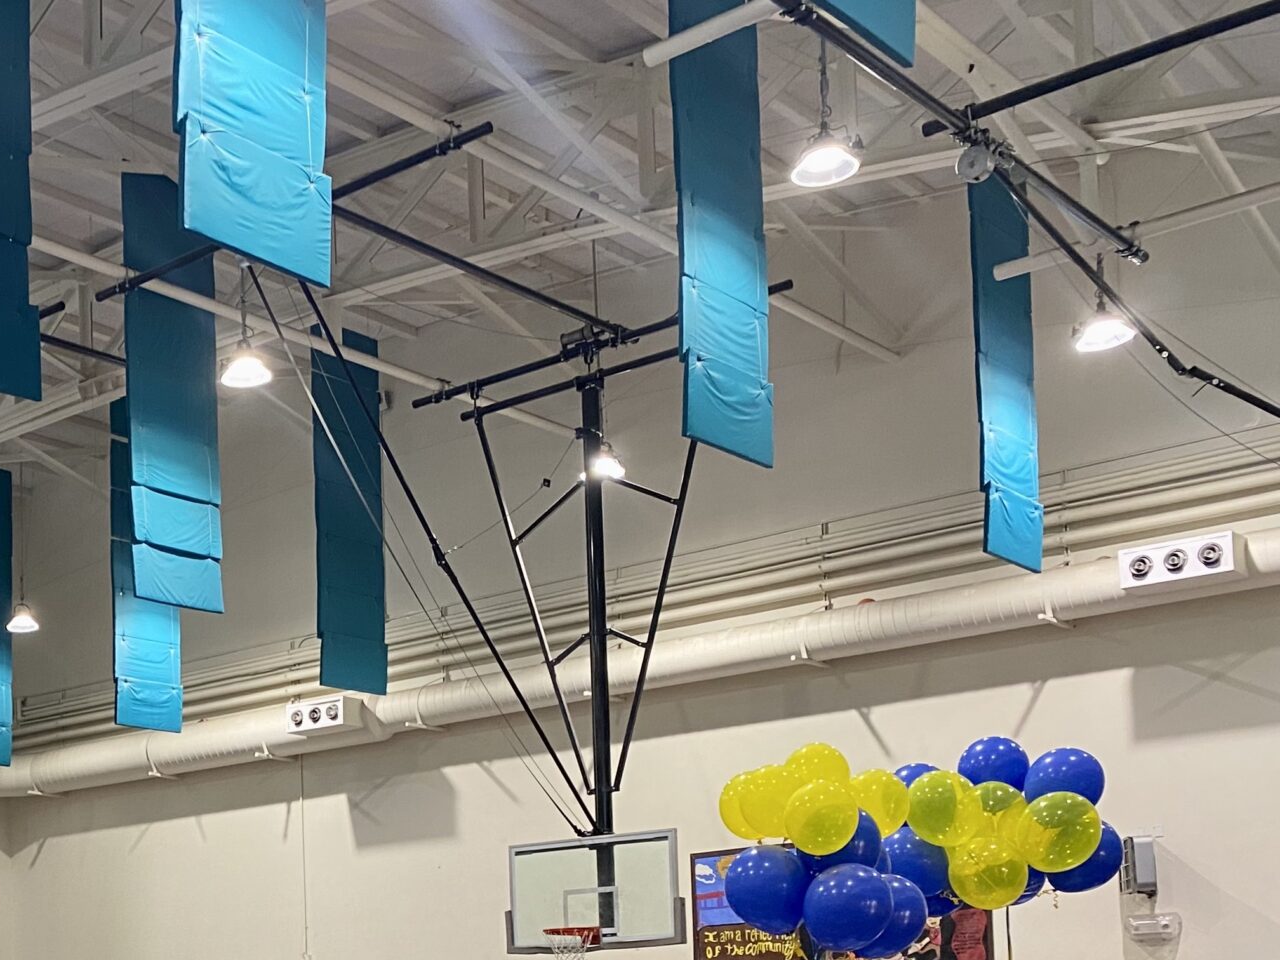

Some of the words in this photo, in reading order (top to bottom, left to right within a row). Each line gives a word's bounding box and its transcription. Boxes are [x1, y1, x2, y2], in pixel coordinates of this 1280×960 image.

[720, 930, 734, 942] am
[735, 930, 742, 942] a
[724, 943, 744, 956] the
